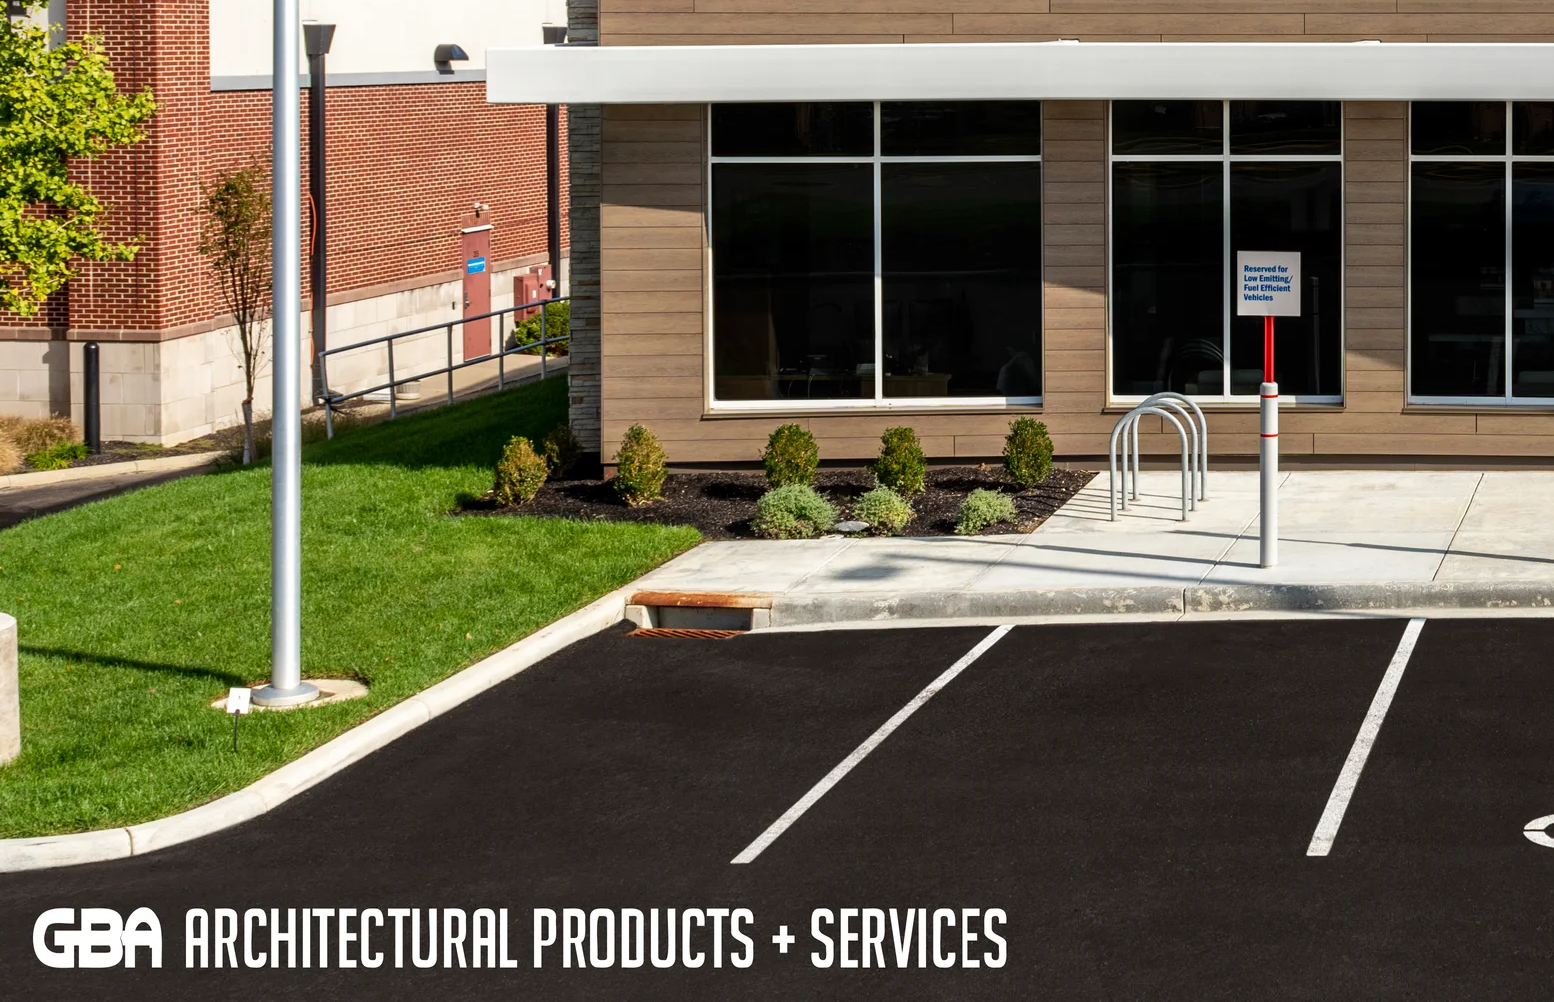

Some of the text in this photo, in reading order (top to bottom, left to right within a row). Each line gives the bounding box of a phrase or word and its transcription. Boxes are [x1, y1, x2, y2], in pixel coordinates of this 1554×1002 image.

[1244, 265, 1288, 273] Reserved for
[1244, 274, 1294, 284] Low Emitting/
[1260, 284, 1291, 292] Efficient
[1244, 293, 1274, 301] Vehicles
